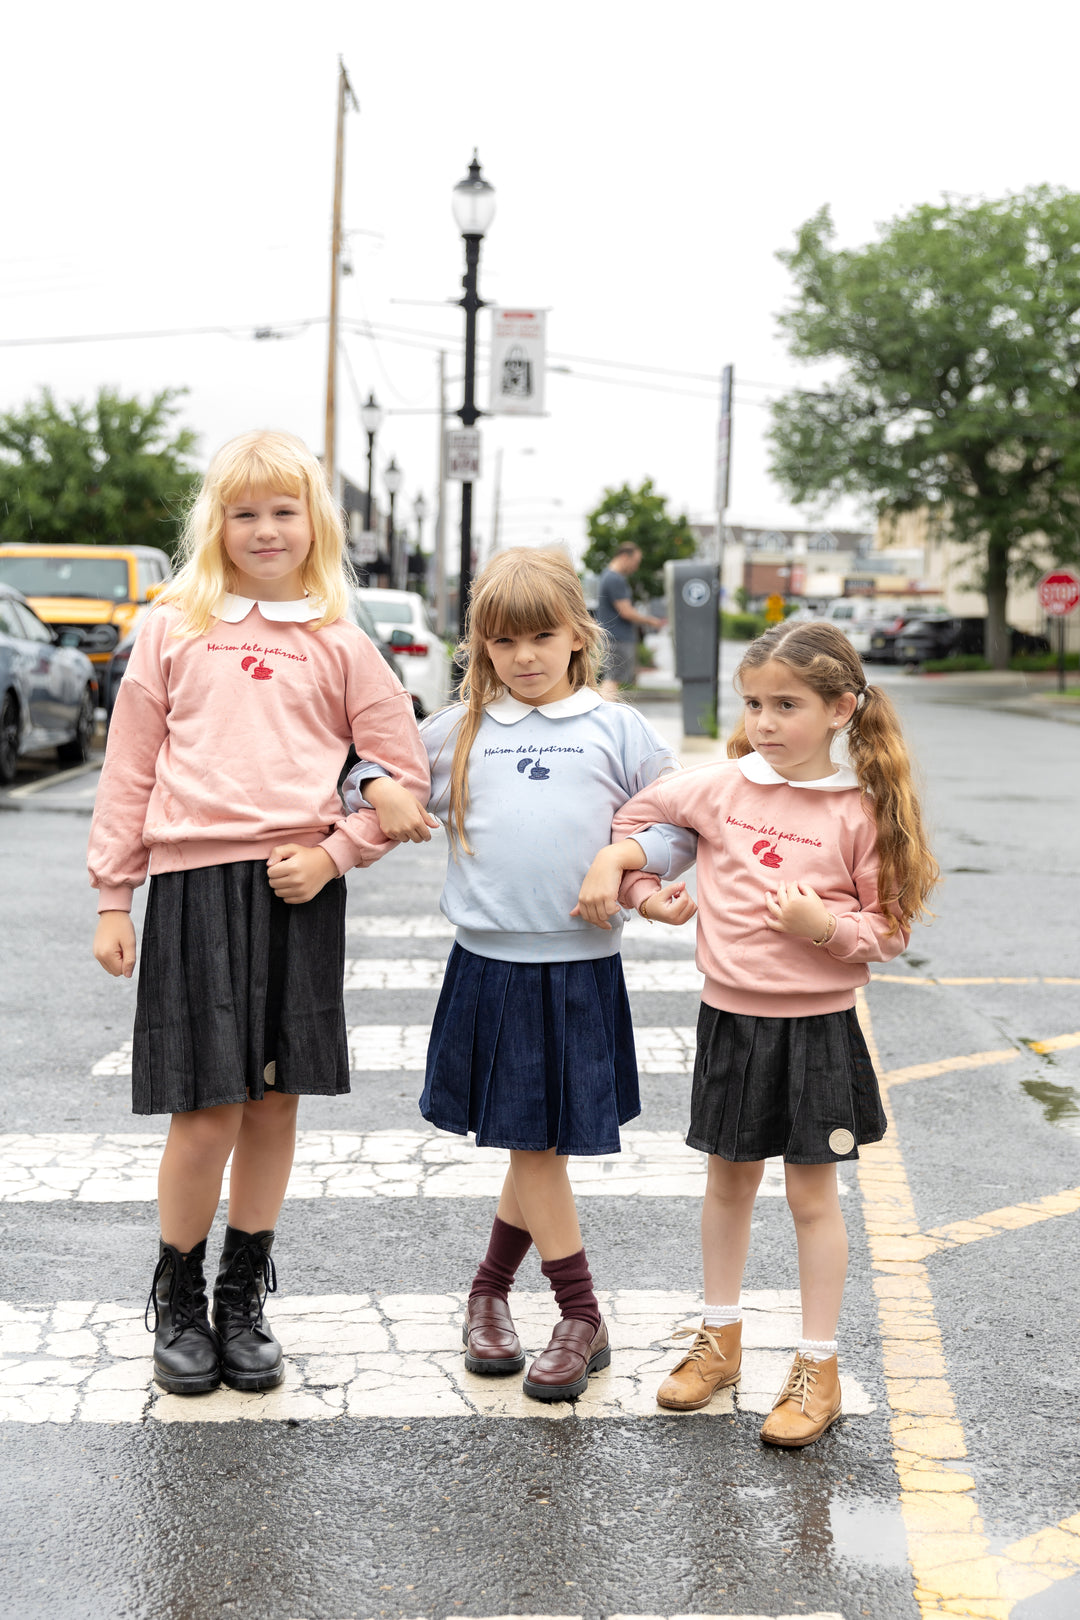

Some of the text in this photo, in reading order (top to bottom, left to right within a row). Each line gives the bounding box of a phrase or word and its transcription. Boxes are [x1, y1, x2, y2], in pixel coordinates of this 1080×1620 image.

[1041, 583, 1077, 601] STOP
[207, 643, 239, 652] Maison
[264, 647, 308, 662] patisserie
[484, 747, 515, 757] Maison
[539, 745, 584, 755] patisserie
[726, 816, 757, 832] Maison
[778, 832, 822, 848] patisserie
